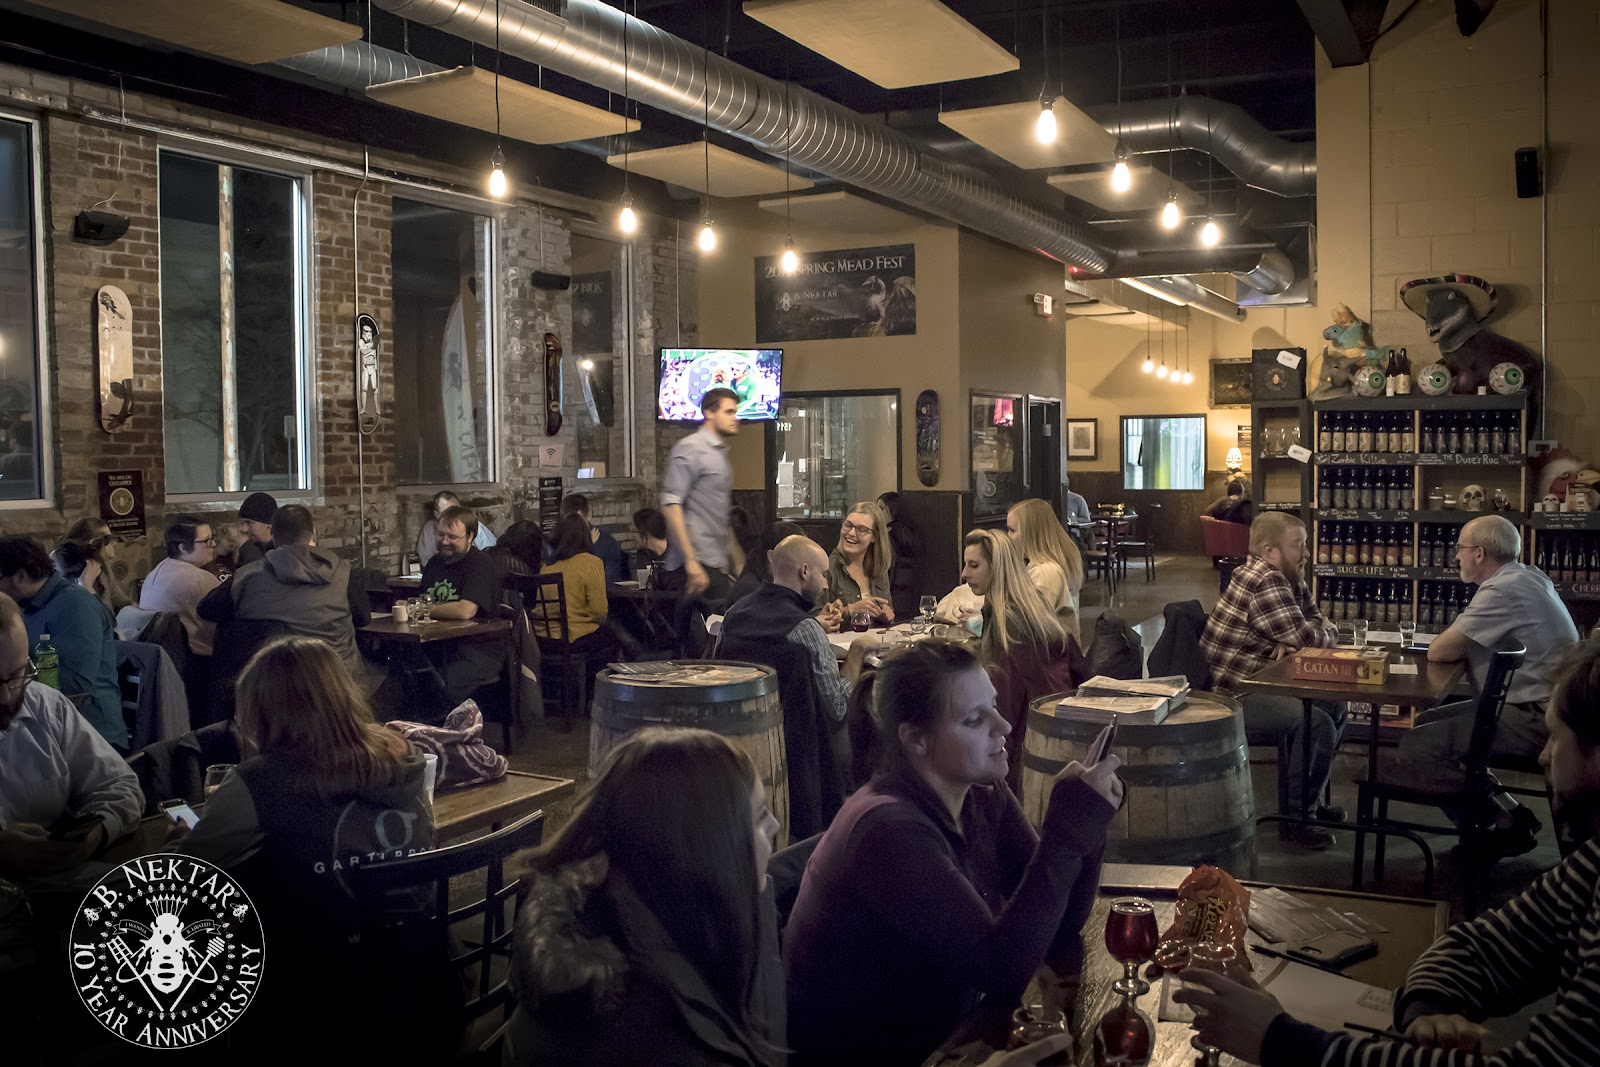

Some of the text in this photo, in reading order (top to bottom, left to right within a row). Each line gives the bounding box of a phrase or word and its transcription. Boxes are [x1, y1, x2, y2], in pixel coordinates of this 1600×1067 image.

[837, 258, 874, 273] MEAD
[876, 255, 905, 270] FEST
[1365, 566, 1385, 577] LIFE
[1303, 661, 1339, 676] CATAN
